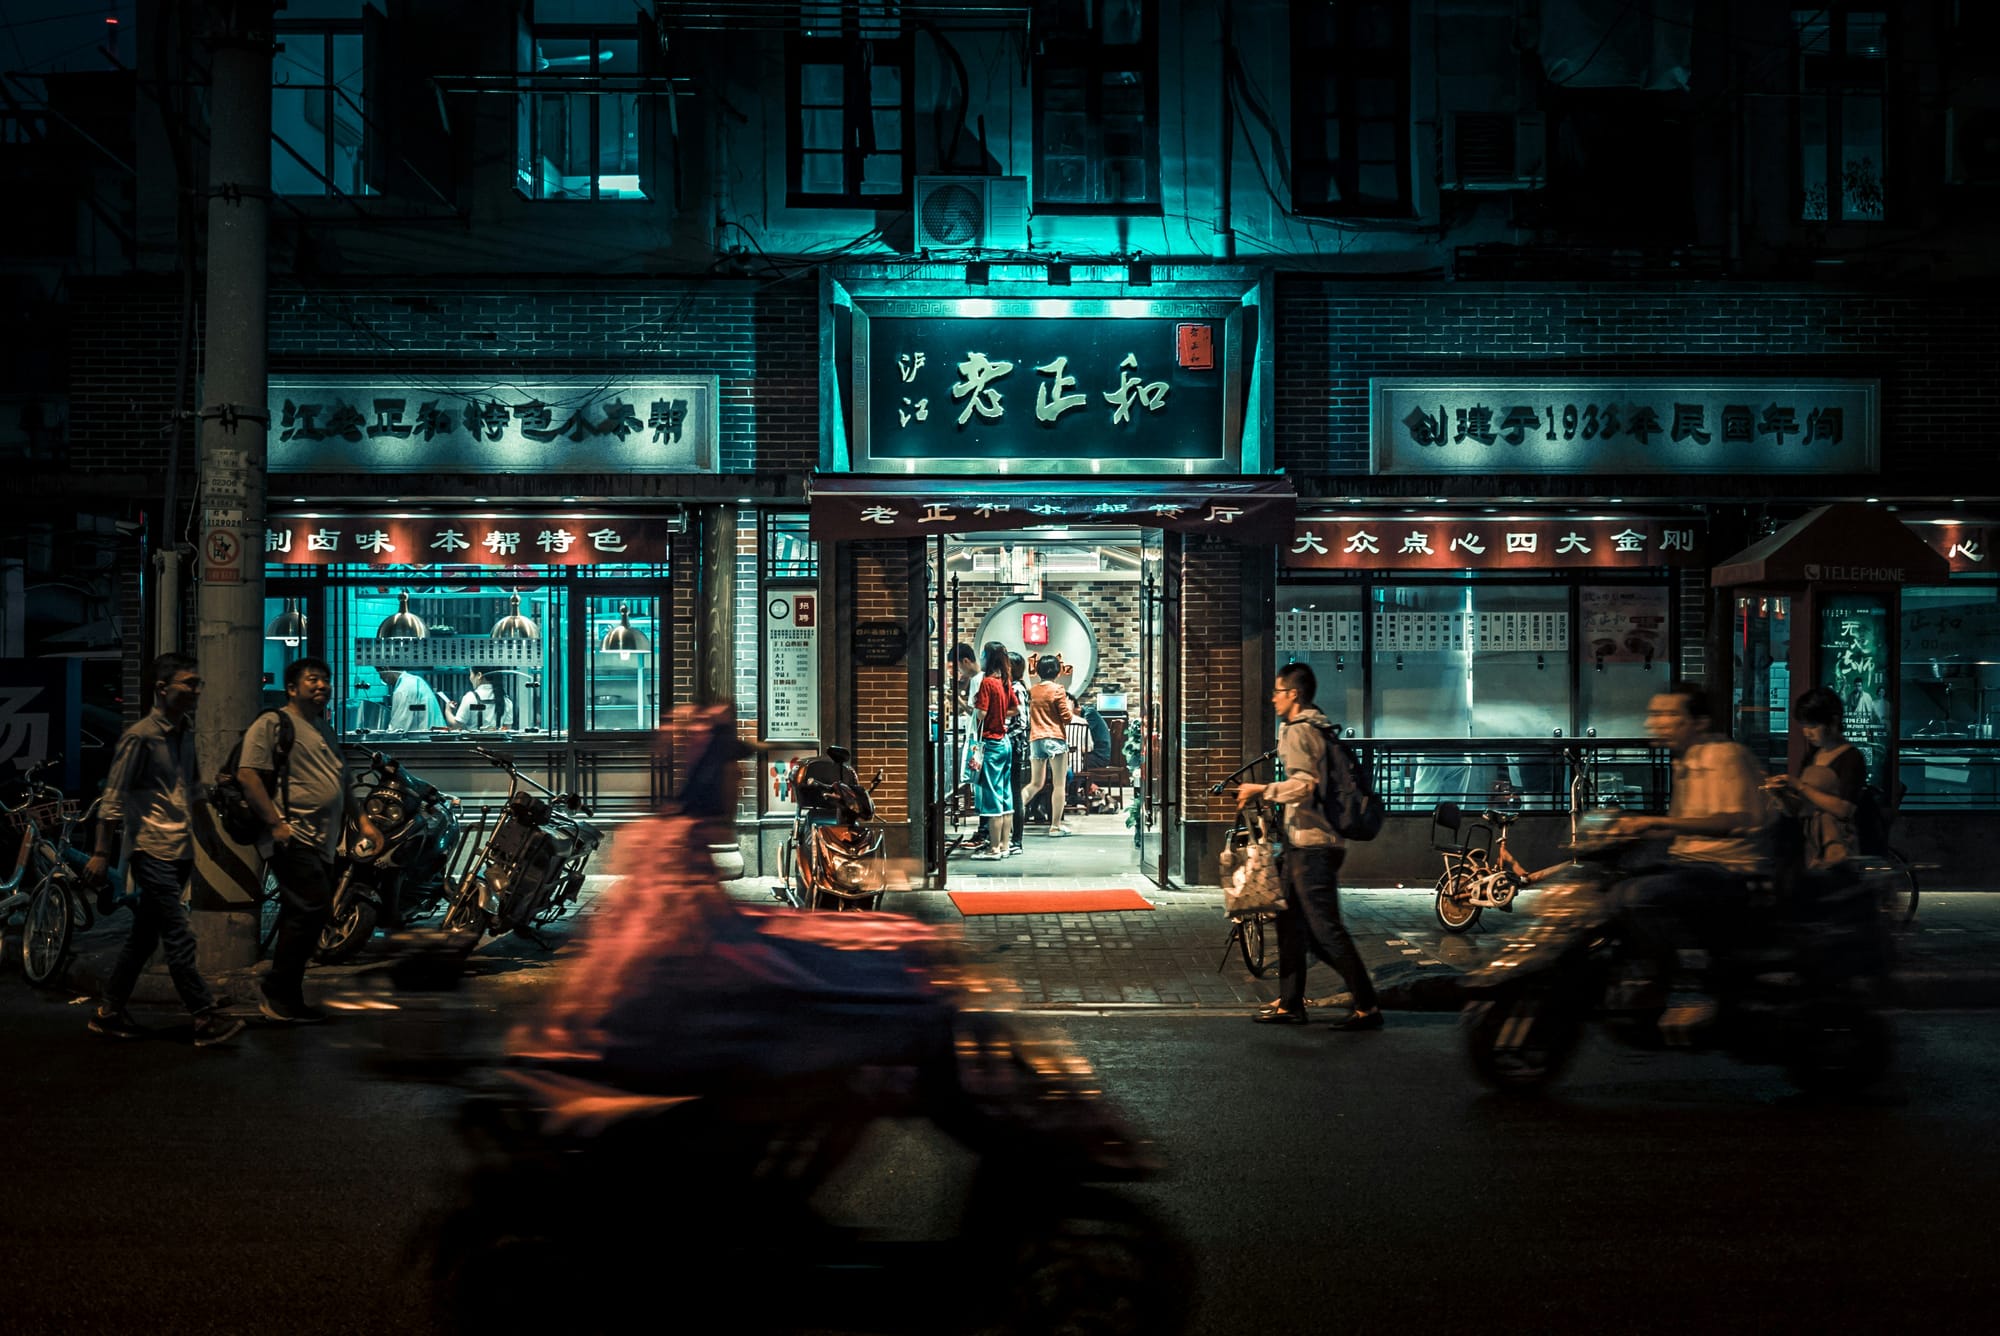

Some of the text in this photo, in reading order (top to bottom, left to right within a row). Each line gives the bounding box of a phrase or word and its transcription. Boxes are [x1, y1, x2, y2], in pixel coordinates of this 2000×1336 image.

[951, 352, 1170, 425] 老正和
[860, 502, 1245, 525] 老正和本帮餐厅
[430, 528, 629, 554] 本帮特色
[1291, 528, 1693, 555] 大众点心四大金刚
[1949, 539, 1985, 562] 心
[1823, 565, 1905, 582] TELEPHONE
